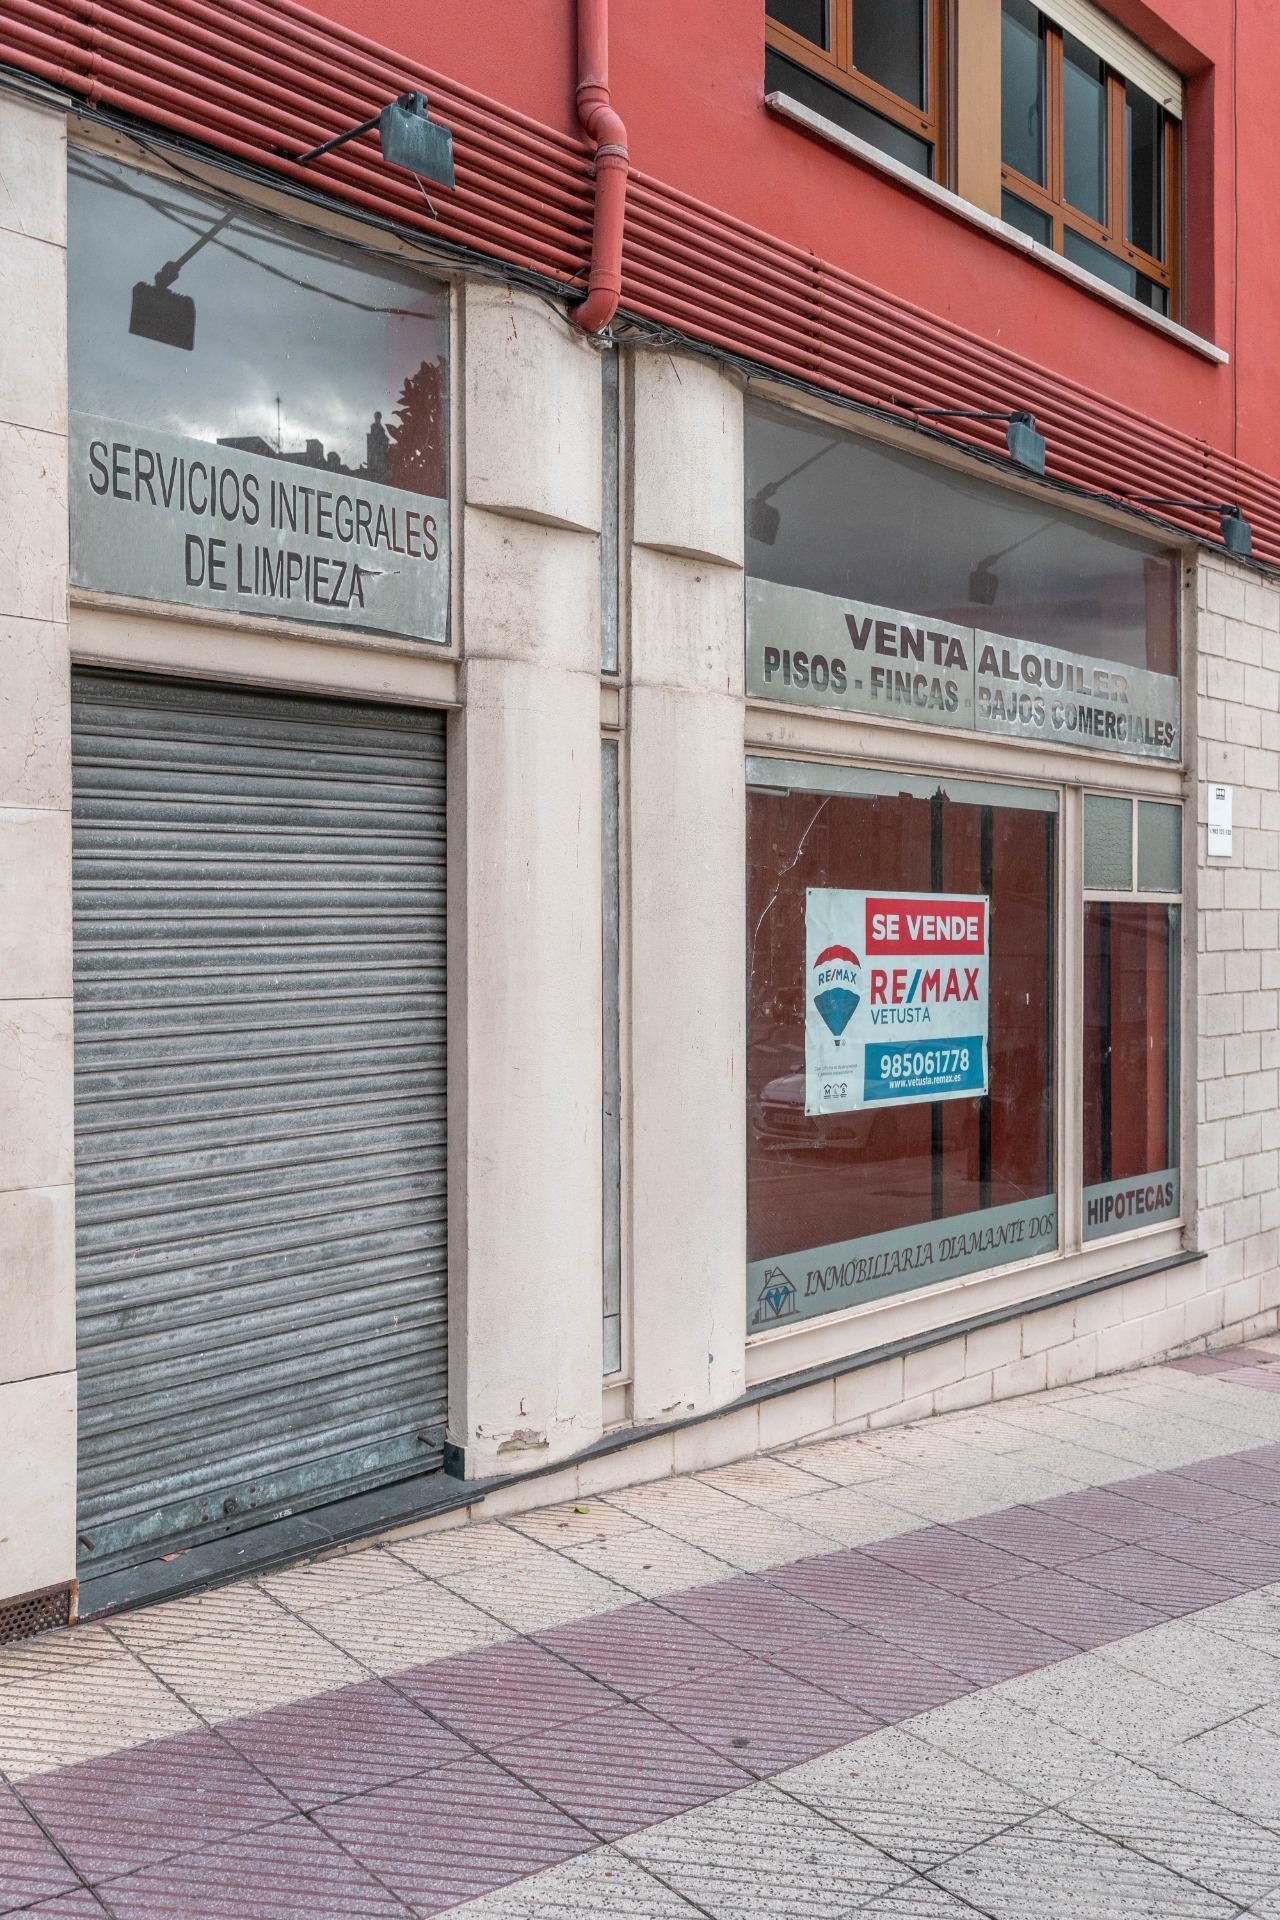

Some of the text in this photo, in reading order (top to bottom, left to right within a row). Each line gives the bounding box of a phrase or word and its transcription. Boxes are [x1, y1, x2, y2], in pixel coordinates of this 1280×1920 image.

[88, 440, 439, 562] SERVICIOS INTEGRALES
[185, 533, 365, 609] DE LIMPIEZA
[844, 613, 1129, 704] VENTA ALQUILER
[764, 646, 848, 695] PISOS
[870, 666, 959, 713] FINCAS
[978, 686, 1046, 727] BAJOS
[1051, 699, 1176, 748] COMERCIALES
[871, 914, 979, 941] SE VENDE
[818, 968, 858, 986] RE/MAX
[870, 967, 980, 1006] RE/MAX
[870, 1007, 931, 1025] VETUSTA
[880, 1048, 970, 1079] 985061778
[889, 1074, 961, 1089] www.vetusta.remax.es
[1087, 1182, 1174, 1226] HIPOTECAS
[938, 1217, 1026, 1262] DIAMANTE
[1029, 1213, 1055, 1240] DOS
